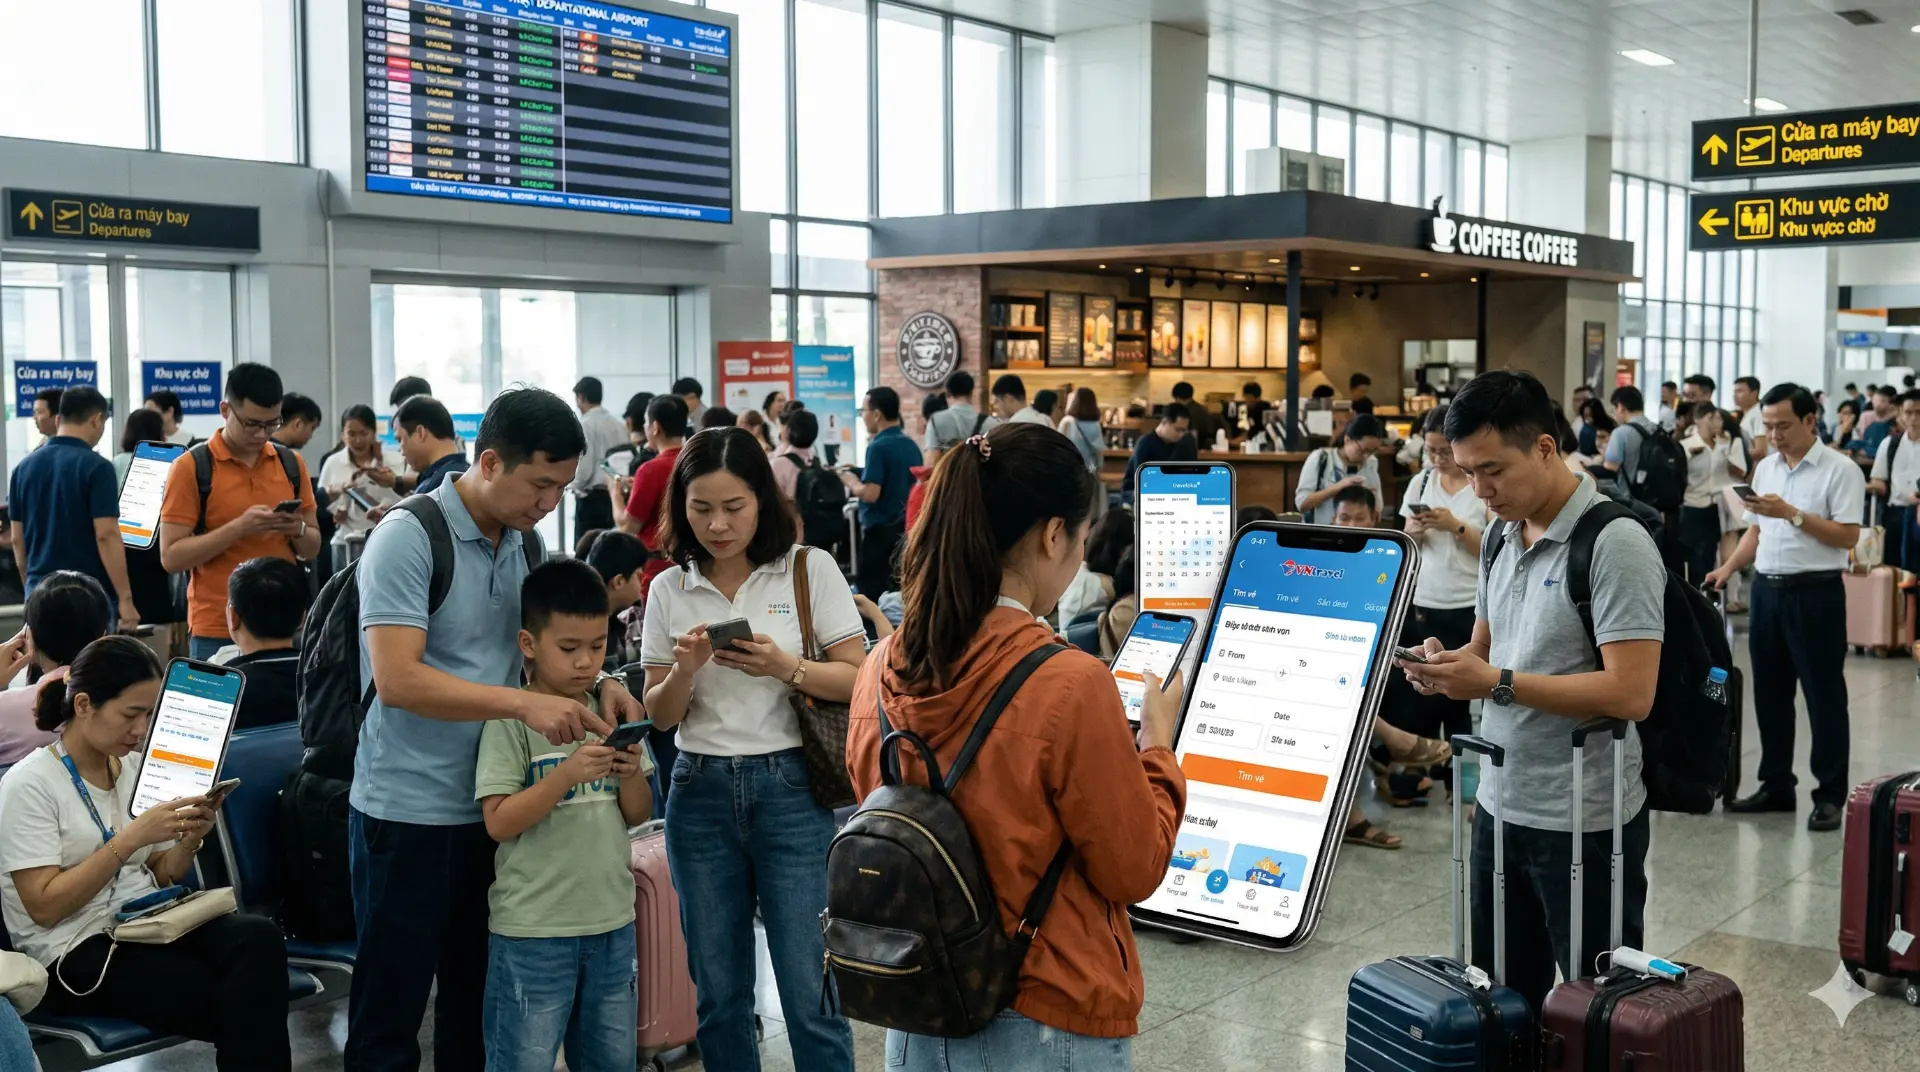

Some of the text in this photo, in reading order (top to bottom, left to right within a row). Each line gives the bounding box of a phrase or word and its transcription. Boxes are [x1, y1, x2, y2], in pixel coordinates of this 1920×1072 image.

[536, 0, 610, 20] DEPARTATIONAL
[610, 11, 650, 28] AIRPORT
[1781, 114, 1920, 142] Cửa ra máy bay
[1781, 144, 1863, 165] Departures
[1779, 191, 1889, 218] Khu vực chờ
[88, 202, 190, 227] Cửa ra máy bay
[89, 222, 152, 239] Departures
[1779, 221, 1808, 238] Khu
[1847, 217, 1876, 235] chờ
[1458, 221, 1578, 267] COFFEE COFFEE
[40, 369, 51, 379] ra
[52, 366, 74, 383] máy
[75, 366, 94, 383] bay
[154, 366, 173, 380] Khu
[1227, 650, 1246, 660] From
[1298, 659, 1307, 668] To
[1200, 700, 1216, 709] Date
[1273, 711, 1291, 721] Date
[1255, 774, 1265, 783] vé
